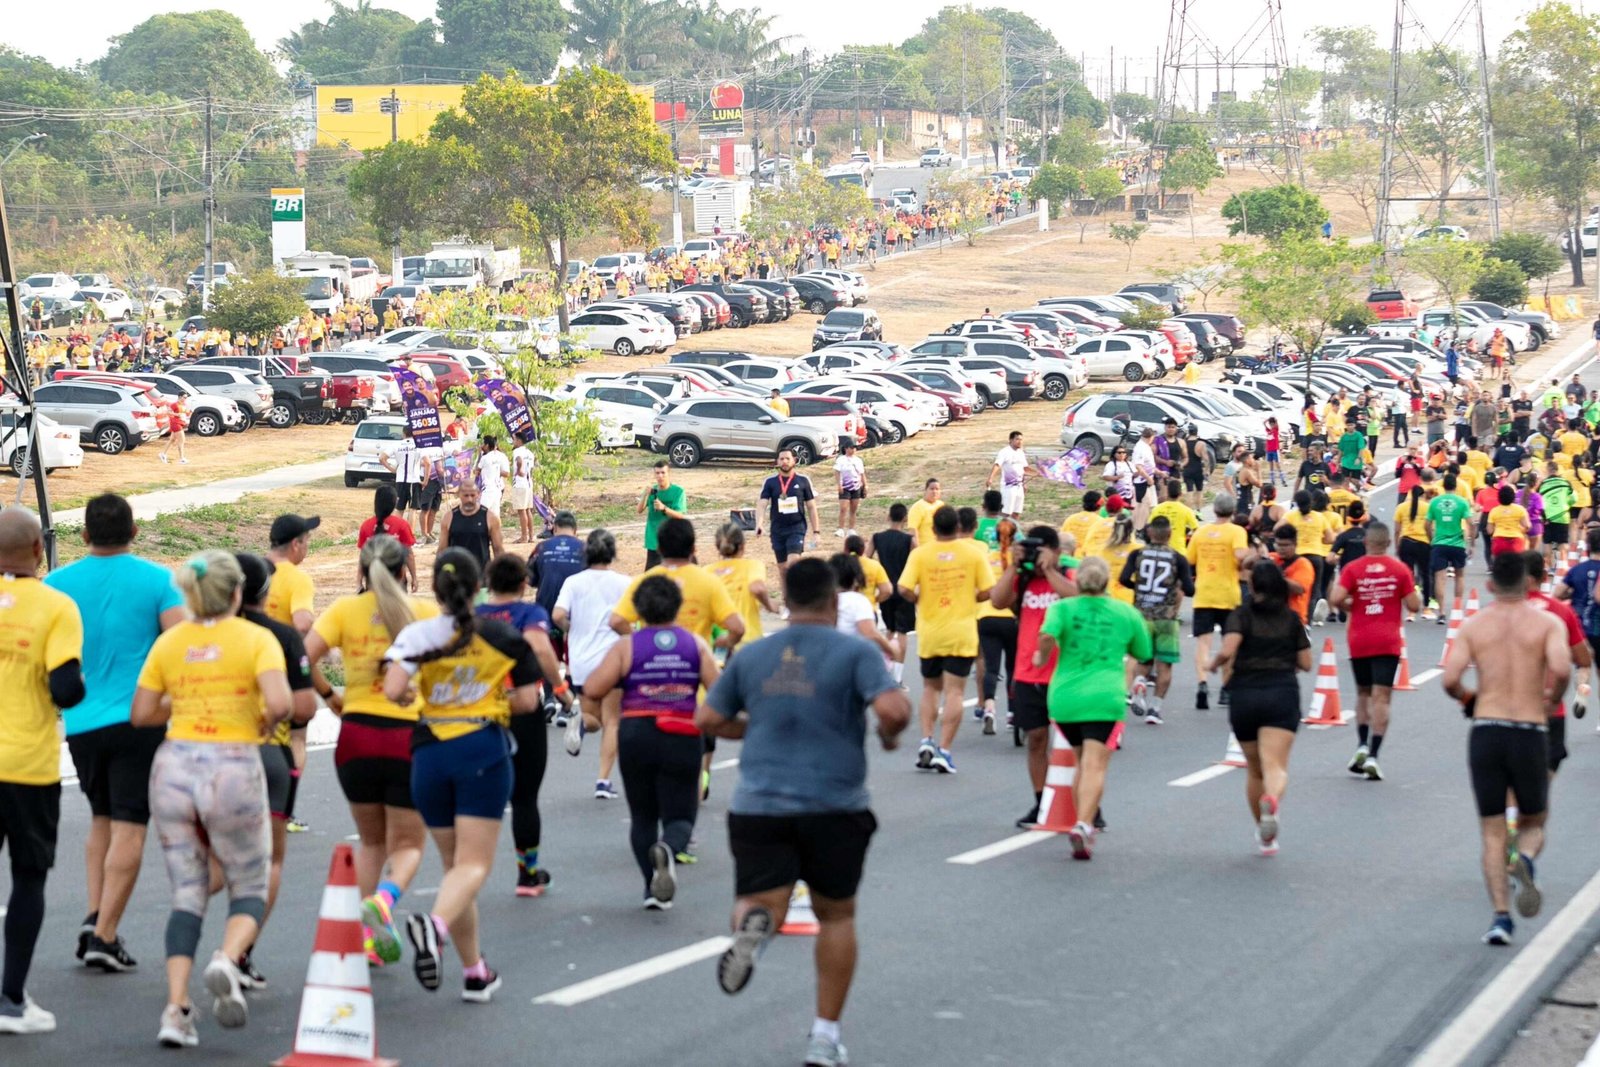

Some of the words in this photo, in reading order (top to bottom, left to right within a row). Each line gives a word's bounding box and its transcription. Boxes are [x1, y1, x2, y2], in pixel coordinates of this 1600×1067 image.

[712, 108, 742, 120] LUNA
[274, 199, 300, 211] BR
[409, 407, 436, 418] JANJÃO
[411, 416, 438, 429] 36036
[1138, 559, 1171, 594] 92
